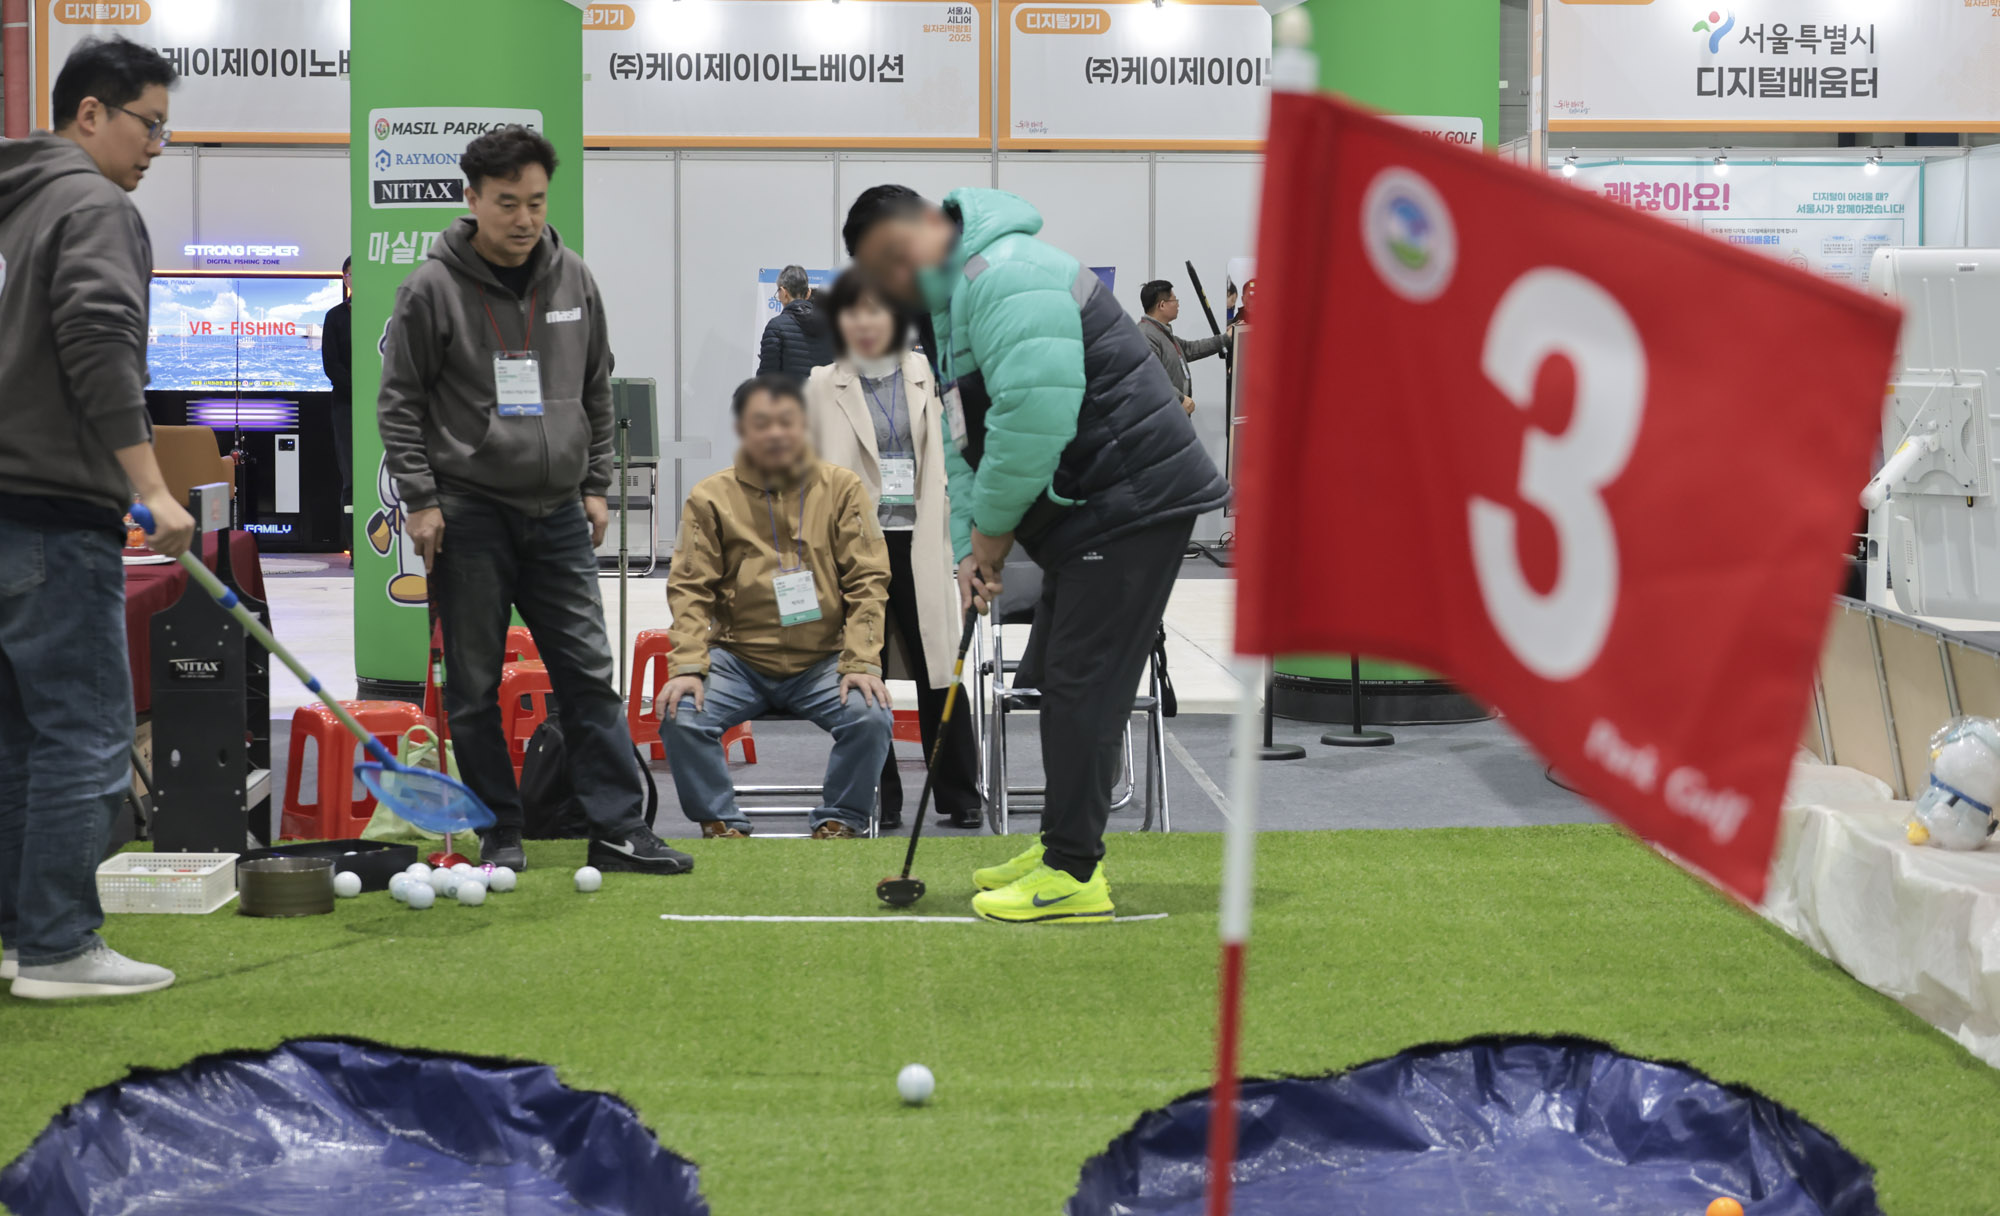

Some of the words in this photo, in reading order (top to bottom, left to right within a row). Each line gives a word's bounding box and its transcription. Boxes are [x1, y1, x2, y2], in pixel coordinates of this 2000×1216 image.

[65, 3, 140, 20] 디지털기기
[583, 9, 624, 25] 털기기
[947, 6, 972, 15] 서울시
[947, 16, 972, 24] 시니어
[1026, 13, 1100, 30] 디지털기기
[923, 24, 972, 33] 일자리박람회
[948, 33, 972, 42] 2025
[1739, 23, 1875, 55] 서울특별시
[609, 52, 904, 83] (주)케이제이이노베이션
[1697, 66, 1878, 98] 디지털배움터
[391, 122, 439, 135] MASIL
[443, 122, 490, 135] PARK
[1445, 131, 1477, 145] GOLF
[381, 182, 453, 200] NITTAX
[1813, 192, 1845, 201] 디지털이
[1848, 192, 1873, 201] 어려울
[1796, 204, 1834, 214] 서울시가
[1837, 204, 1904, 214] 함께하겠습니다!
[184, 245, 245, 256] STRONG
[246, 245, 300, 256] FISHER
[189, 321, 212, 335] VR
[231, 321, 296, 336] FISHING
[1469, 267, 1648, 680] 3
[245, 524, 292, 534] FAMILY
[176, 661, 219, 671] NITTAX
